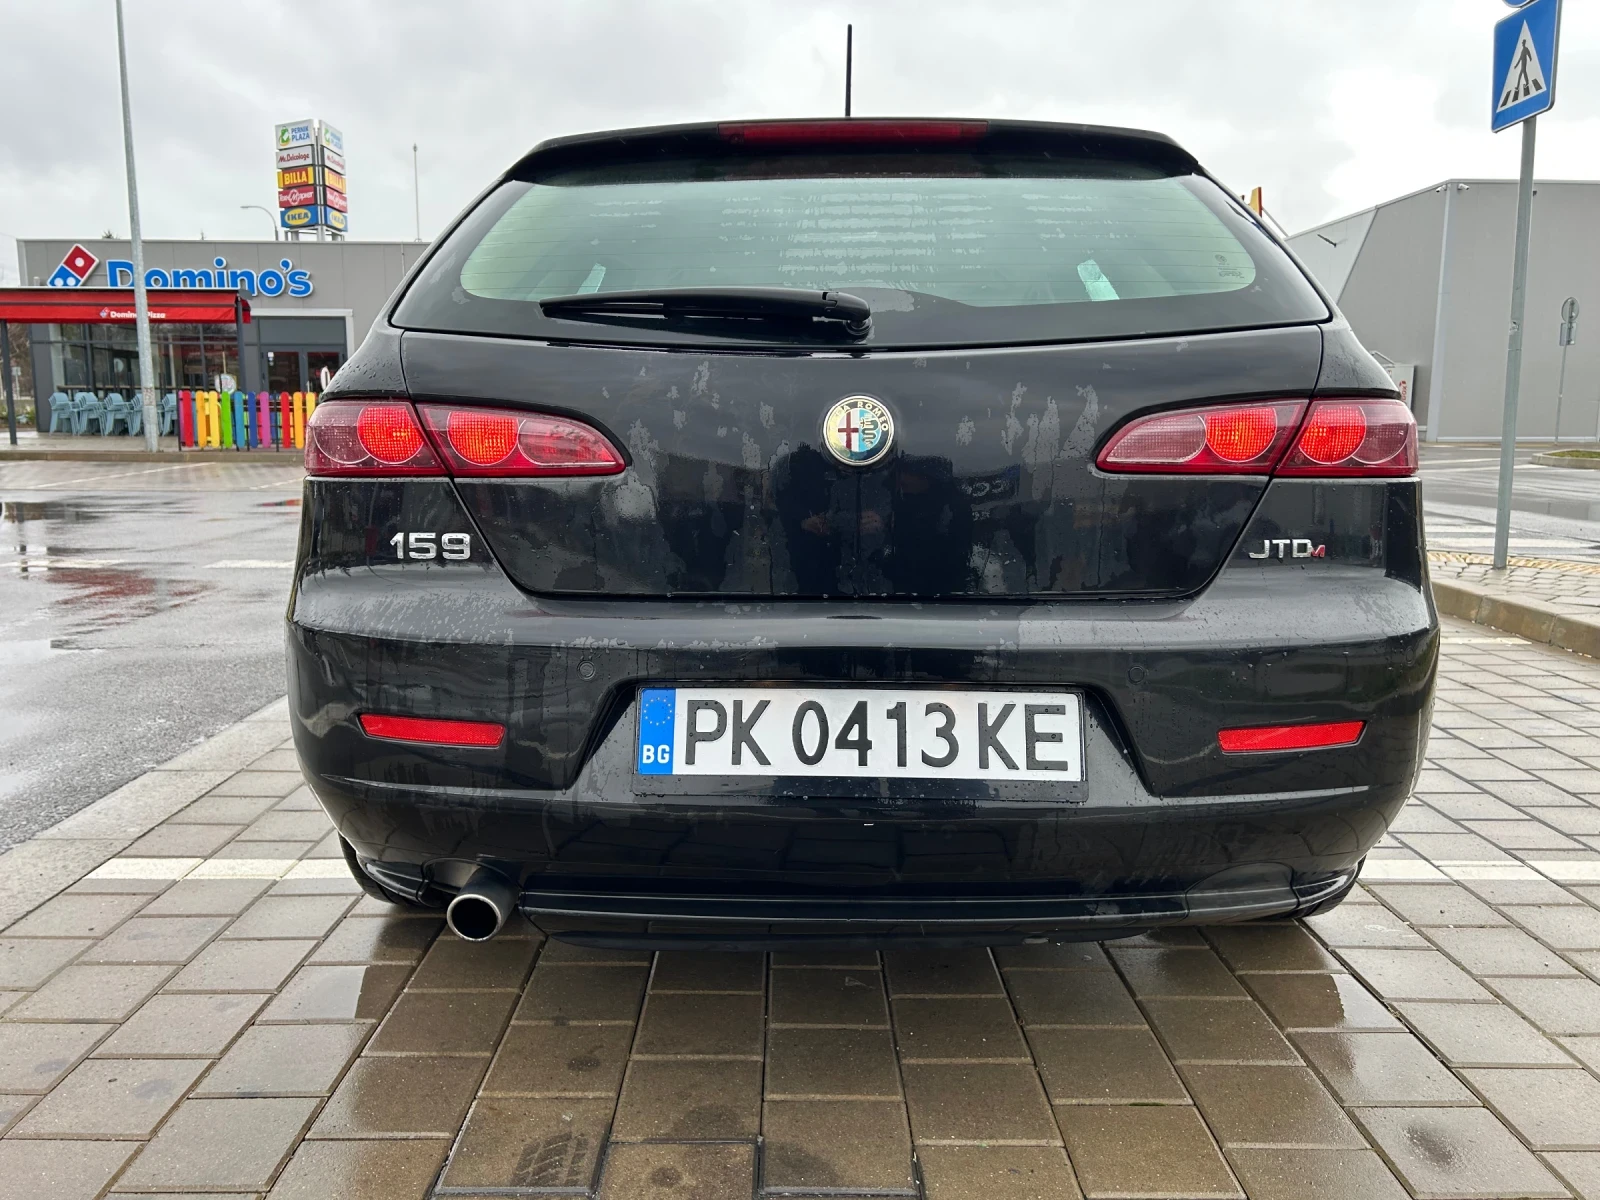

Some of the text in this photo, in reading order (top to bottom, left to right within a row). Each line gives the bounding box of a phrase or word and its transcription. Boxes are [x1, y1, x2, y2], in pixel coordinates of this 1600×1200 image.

[291, 132, 310, 141] PLAZA
[284, 171, 307, 185] BILLA
[287, 212, 309, 222] IKEA
[106, 257, 314, 297] Domino's
[857, 401, 889, 432] ROMEO
[389, 532, 471, 560] 159
[685, 699, 1069, 772] PK 0413 KE
[642, 744, 670, 764] BG
